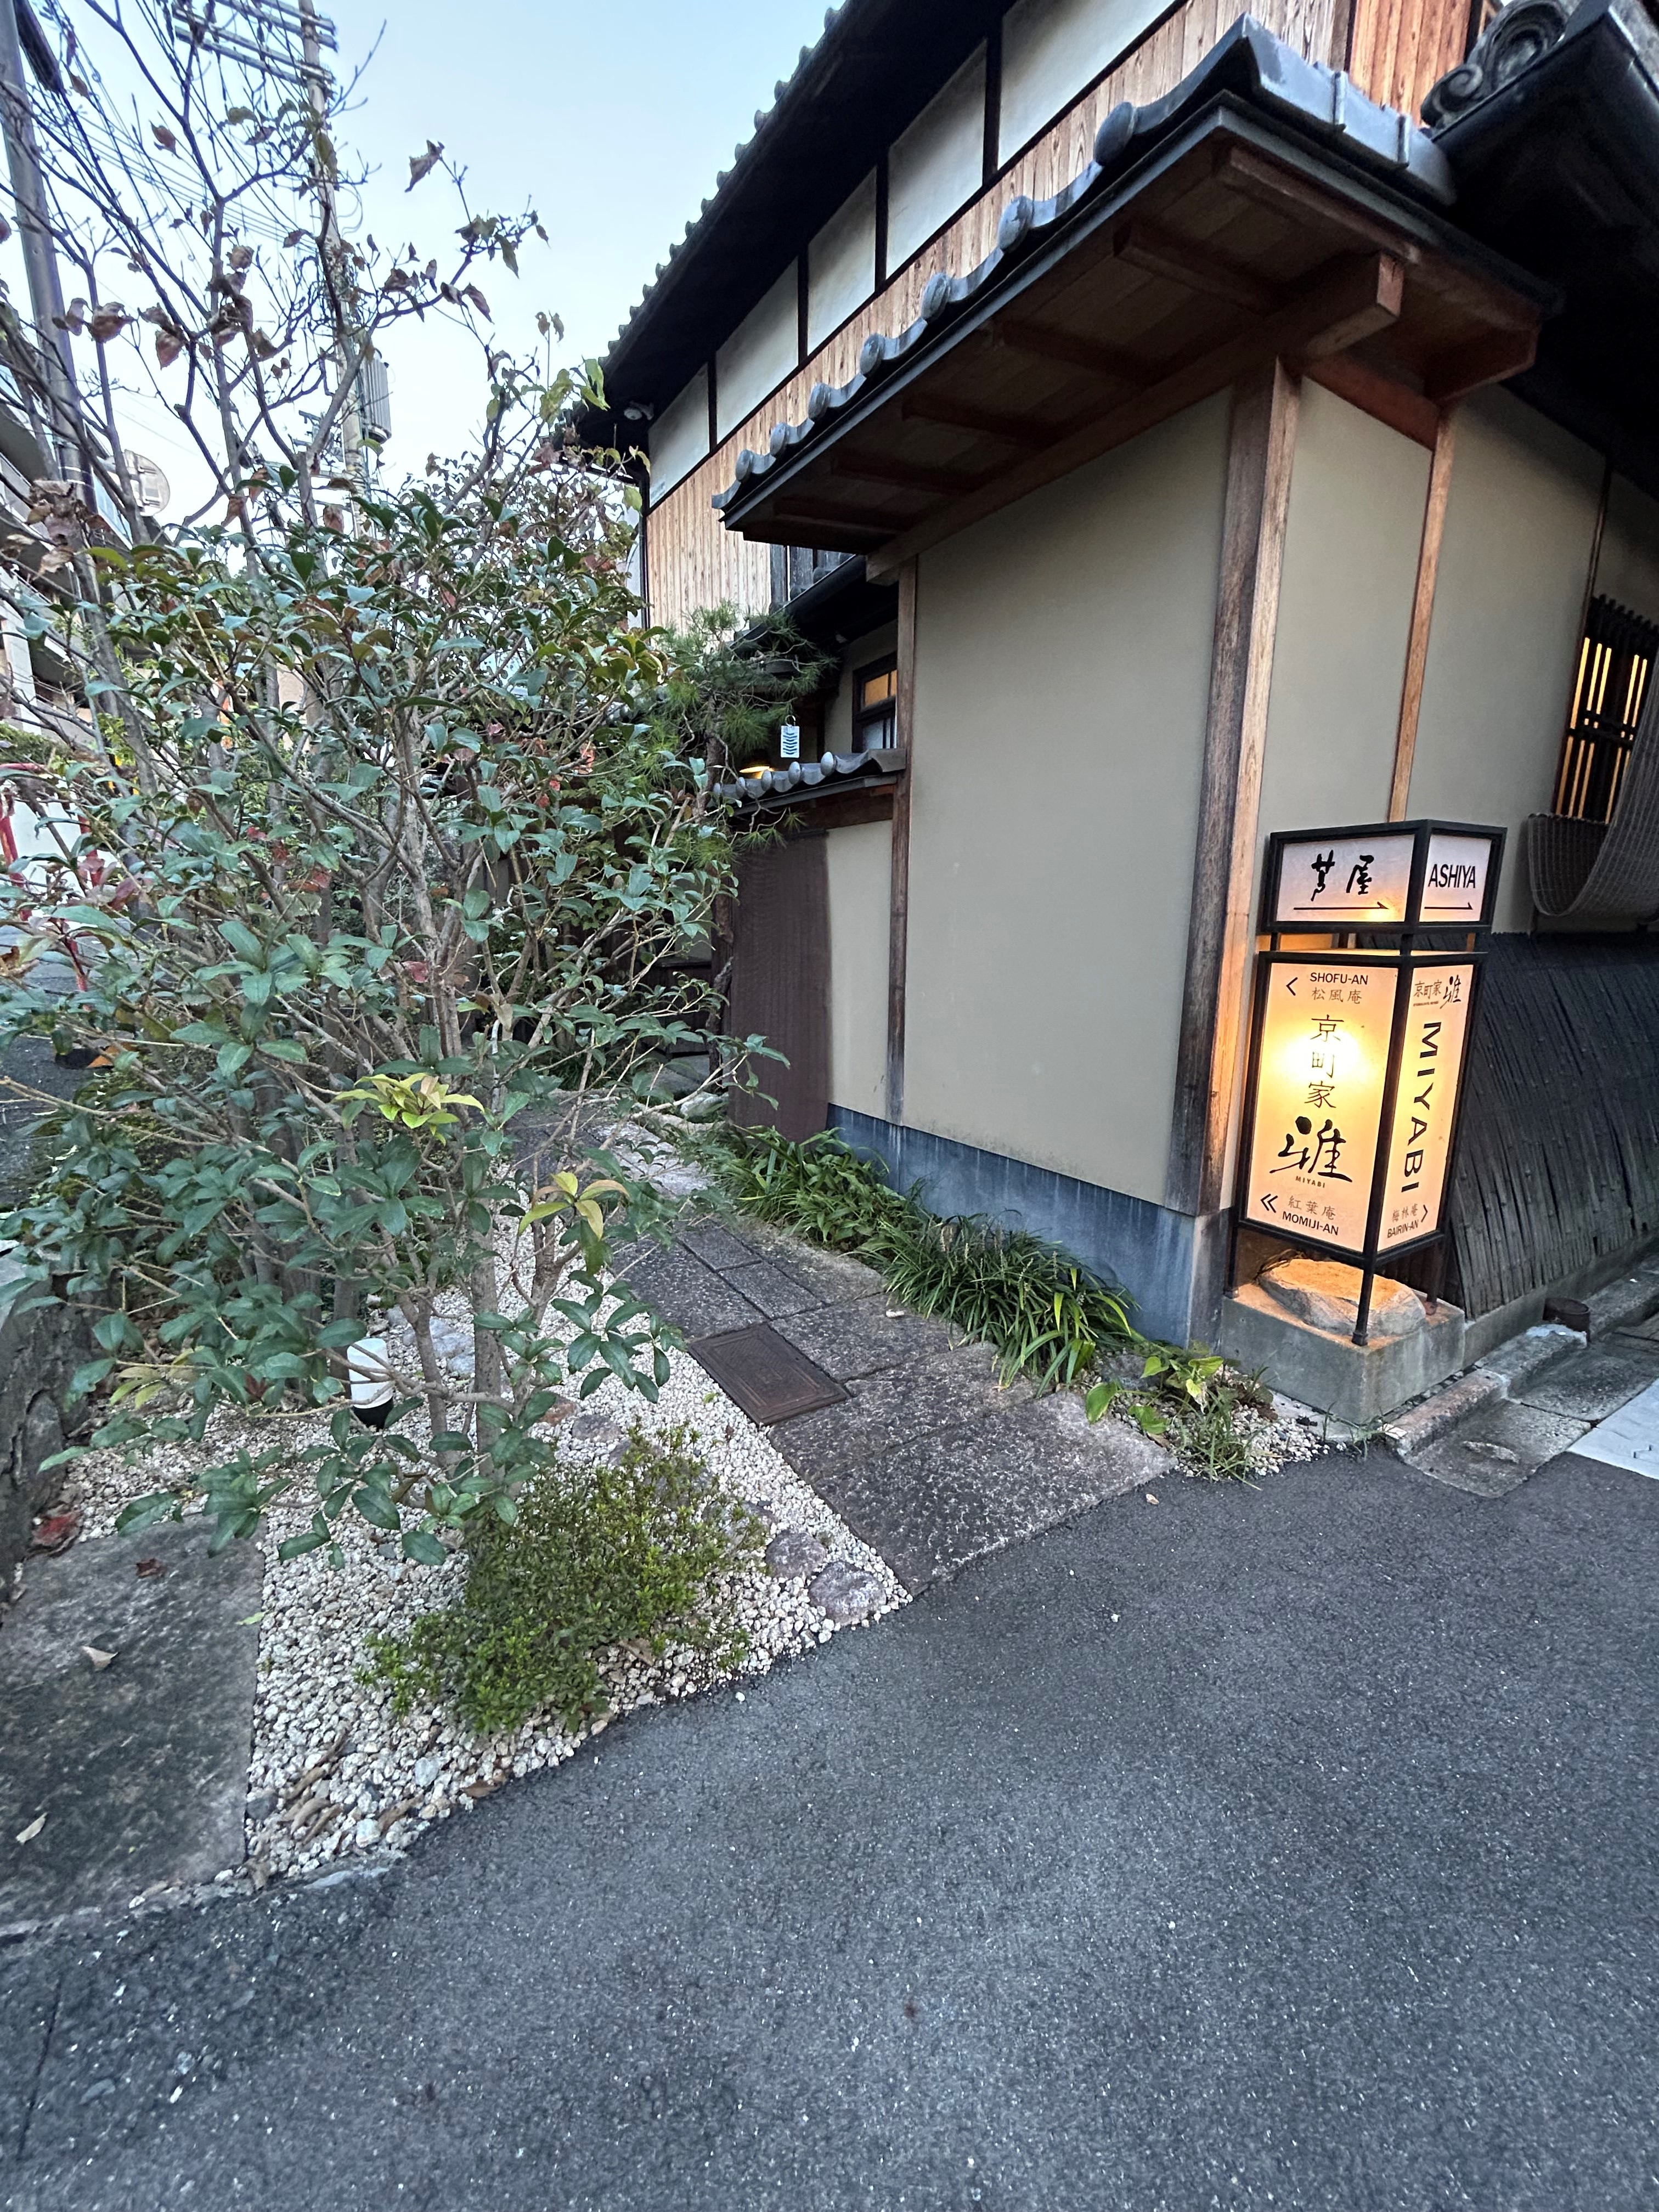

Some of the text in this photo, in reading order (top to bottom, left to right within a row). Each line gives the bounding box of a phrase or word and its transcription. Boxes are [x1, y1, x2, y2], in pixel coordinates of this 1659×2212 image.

[1427, 864, 1476, 889] ASHIYA
[1310, 972, 1368, 985] SHOFU-AN
[1413, 979, 1442, 999] 京町家
[1311, 987, 1362, 1005] 松風庵
[1304, 1014, 1344, 1108] 京町家
[1401, 1022, 1442, 1193] MIYABI
[1295, 1176, 1325, 1188] MIYABI
[1288, 1195, 1336, 1221] 紅葉庵
[1282, 1211, 1339, 1235] MOMIJI-AN
[1386, 1219, 1419, 1239] BAIRIN-AN
